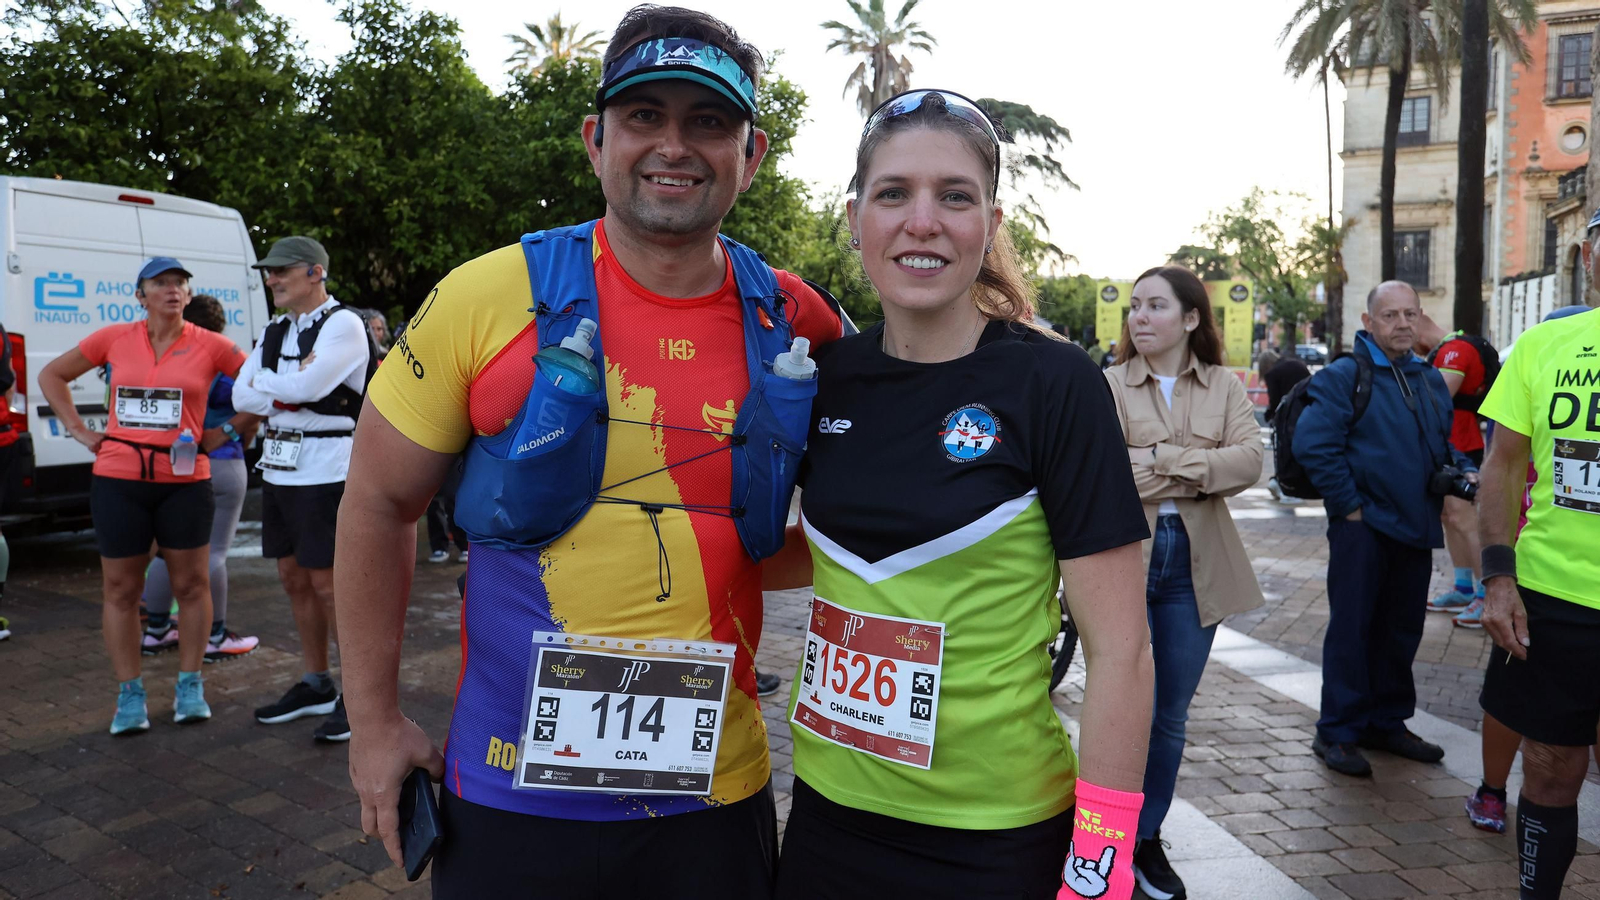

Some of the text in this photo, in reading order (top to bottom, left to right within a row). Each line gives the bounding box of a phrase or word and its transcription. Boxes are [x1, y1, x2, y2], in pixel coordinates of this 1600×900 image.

[34, 311, 90, 325] INAUTO
[140, 399, 158, 414] 85
[270, 440, 283, 456] 86
[516, 427, 565, 455] SALOMON
[895, 635, 931, 651] Sherry
[550, 664, 587, 679] Sherry
[820, 642, 898, 707] 1526
[680, 674, 715, 689] Sherry
[591, 693, 666, 742] 114
[830, 701, 885, 726] CHARLENE
[615, 750, 648, 761] CATA
